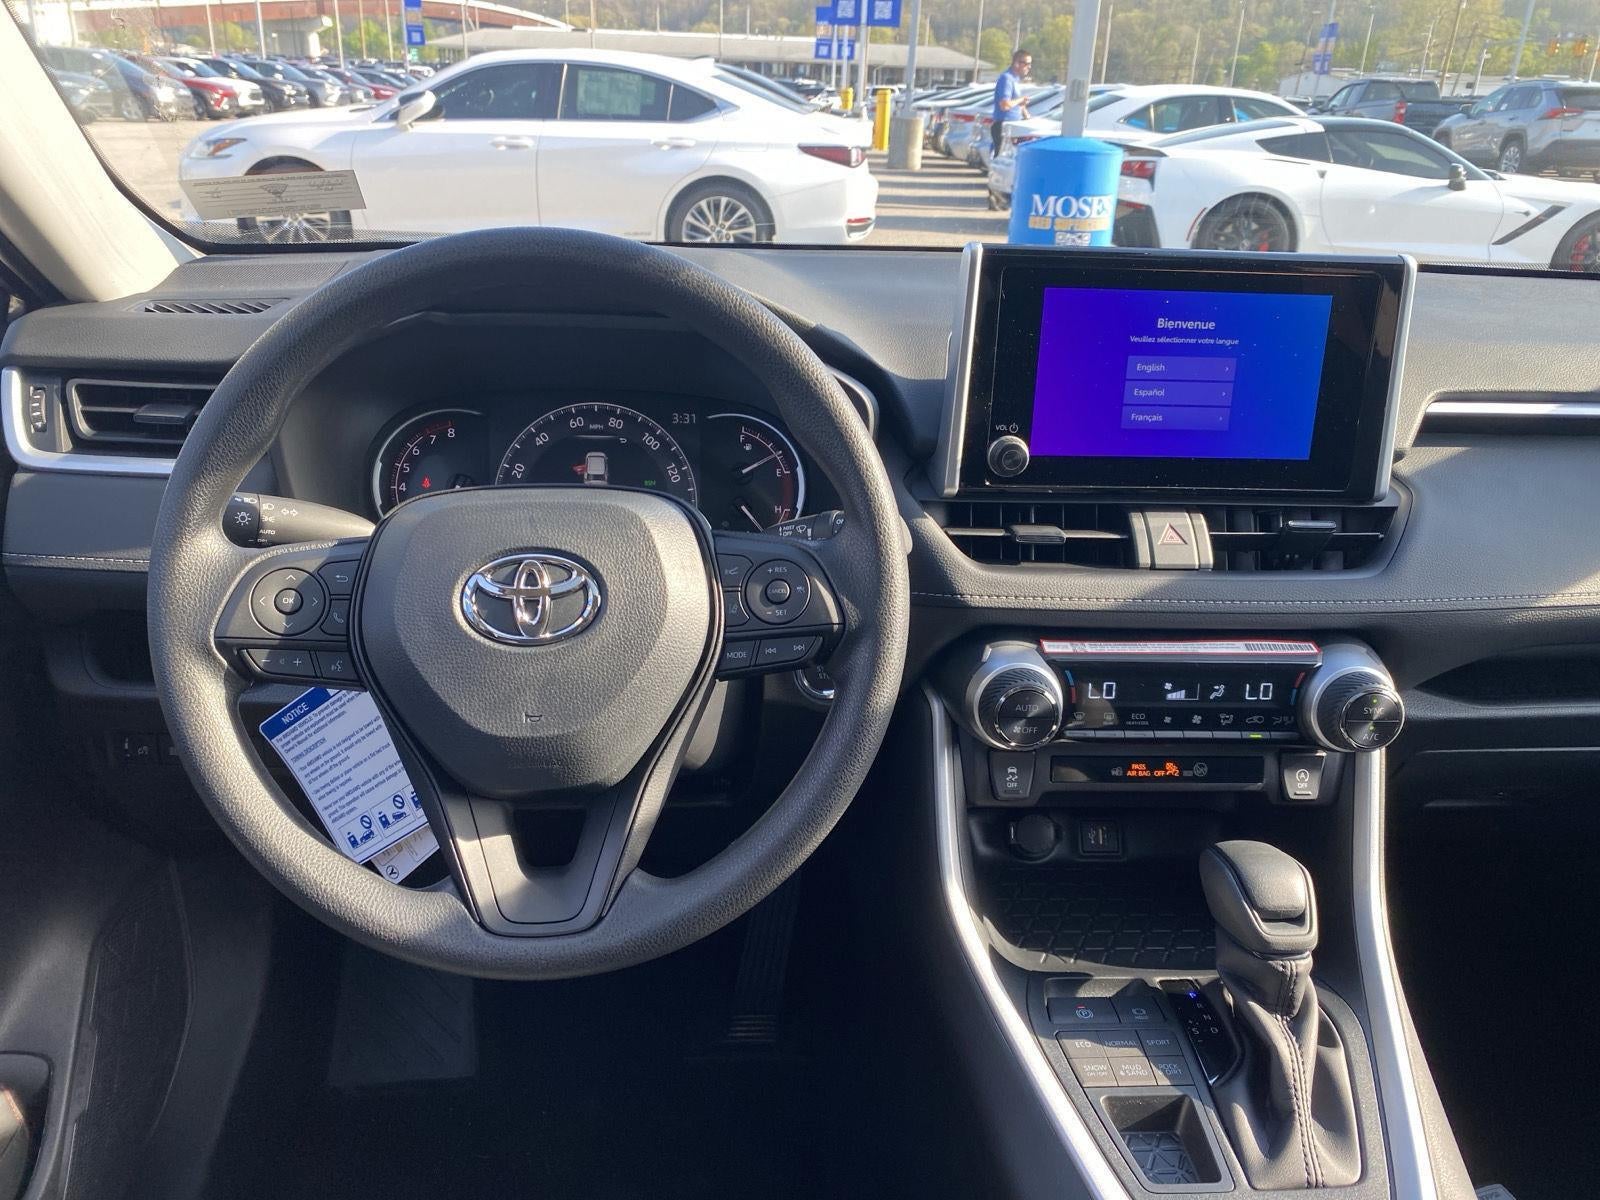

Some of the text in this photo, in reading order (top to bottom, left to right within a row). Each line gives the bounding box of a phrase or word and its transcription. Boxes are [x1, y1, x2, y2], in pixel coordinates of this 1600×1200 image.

[1157, 318, 1216, 331] Bienvenue
[1130, 335, 1239, 346] Veuillez sélectionner votre langue
[1136, 363, 1165, 373] English
[1134, 388, 1165, 398] Español
[569, 416, 585, 429] 60
[672, 412, 696, 424] 3:31
[1131, 412, 1163, 423] Français
[608, 416, 624, 430] 80
[447, 428, 456, 438] 8
[429, 434, 437, 445] 7
[535, 432, 550, 447] 40
[641, 432, 661, 451] 100
[740, 435, 745, 443] F
[412, 446, 420, 456] 6
[402, 463, 410, 473] 5
[511, 463, 525, 479] 20
[665, 462, 681, 484] 120
[776, 468, 782, 477] E
[398, 482, 407, 492] 4
[775, 505, 782, 513] H
[727, 651, 747, 659] MODE
[1088, 682, 1116, 699] LO
[1245, 682, 1273, 700] LO
[281, 701, 309, 725] NOTICE
[1015, 704, 1039, 712] AUTO
[1022, 726, 1038, 734] OFF
[1362, 733, 1379, 741] A/C
[1192, 1027, 1199, 1035] S
